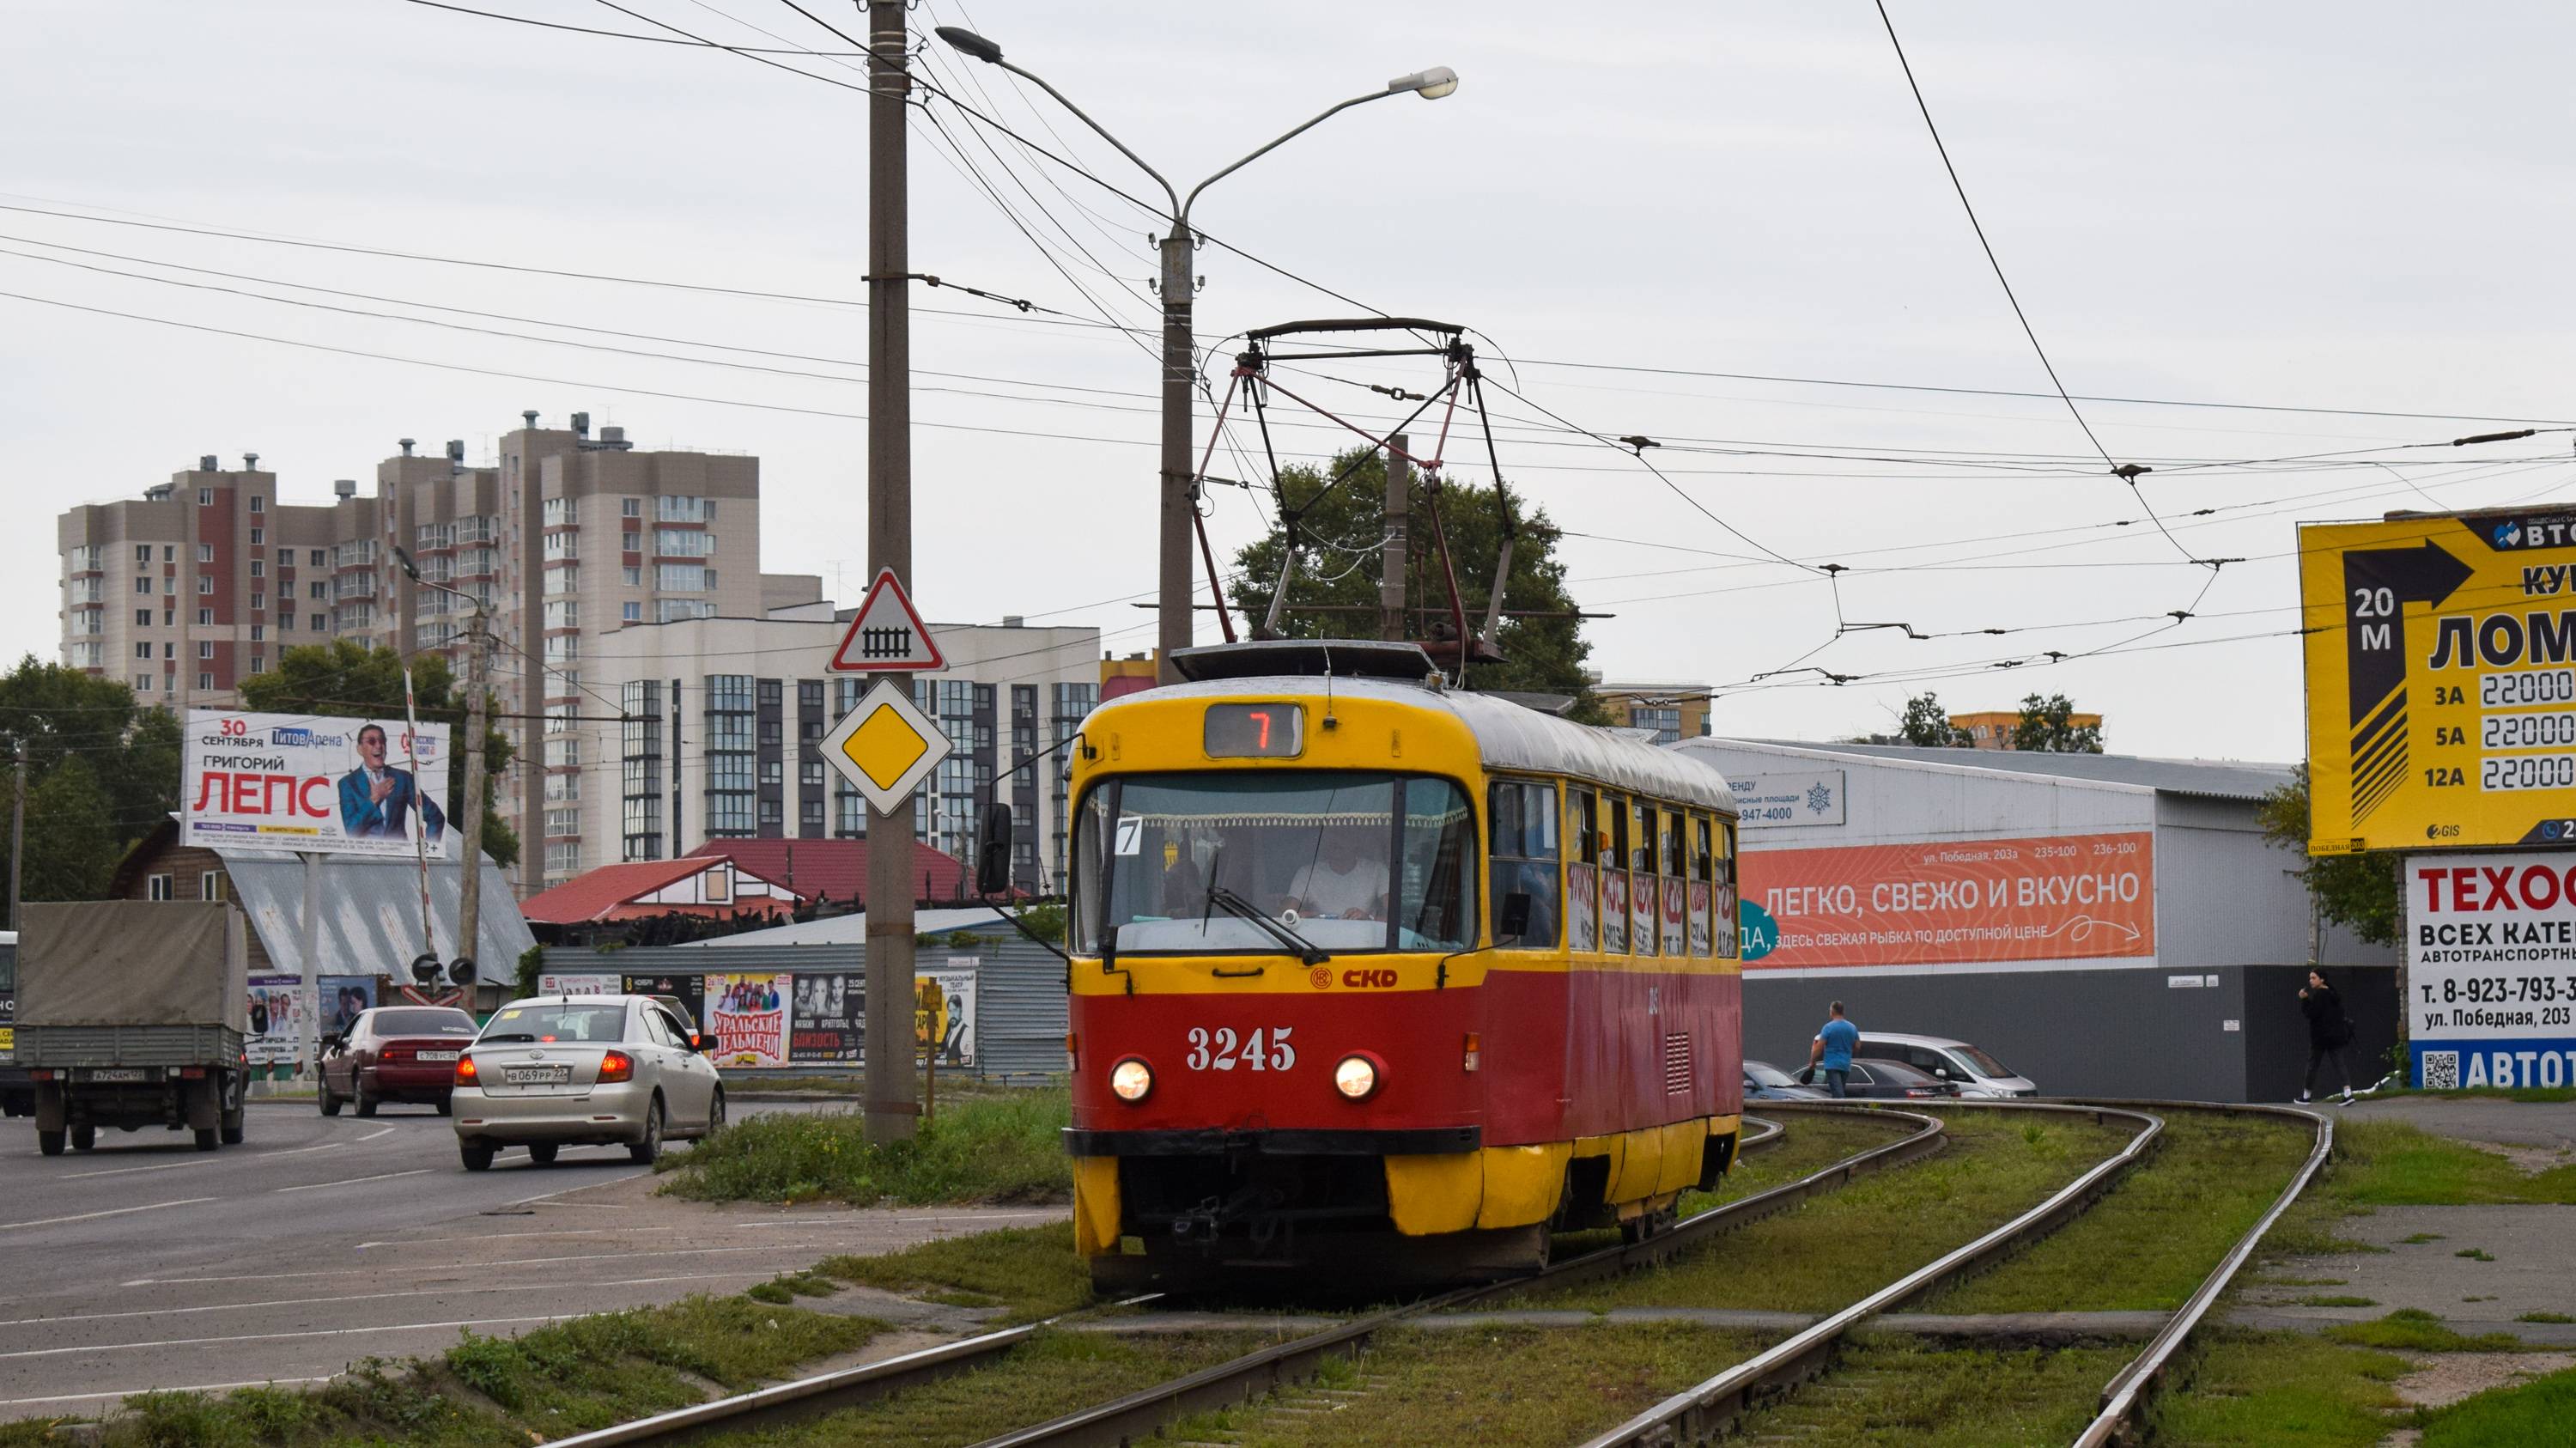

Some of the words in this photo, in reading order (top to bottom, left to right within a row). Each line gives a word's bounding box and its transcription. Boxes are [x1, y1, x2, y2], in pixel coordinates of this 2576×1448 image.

[2523, 564, 2576, 596] КУ
[2354, 587, 2394, 618] 20
[2361, 624, 2391, 650] М
[2428, 611, 2576, 670] ЛОМ
[2434, 686, 2465, 706] 3А
[2483, 670, 2573, 705] 22000
[221, 719, 246, 737] 30
[1250, 712, 1270, 750] 7
[2435, 726, 2466, 746] 5А
[2484, 714, 2575, 748] 22000
[202, 735, 264, 747] СЕНТЯБРЯ
[203, 755, 285, 770] ГРИГОРИЙ
[2424, 767, 2465, 787] 12А
[2483, 756, 2574, 789] 22000
[193, 771, 331, 818] ЛЕПС
[1765, 794, 1800, 805] площади
[1118, 819, 1139, 853] 7
[2426, 824, 2460, 840] 2GIS
[2563, 821, 2576, 837] 2
[1923, 854, 1938, 866] ул.
[1994, 848, 2018, 860] 203а
[2034, 846, 2076, 858] 235-100
[2093, 842, 2136, 855] 236-100
[2311, 843, 2350, 853] ПОБЕДНАЯ
[2351, 838, 2365, 852] 203
[1763, 885, 1863, 919] ЛЕГКО,
[1871, 879, 1979, 912] СВЕЖО
[1989, 878, 2008, 908] И
[2017, 872, 2140, 907] ВКУСНО
[1775, 934, 1814, 949] ЗДЕСЬ
[1816, 932, 1867, 946] СВЕЖАЯ
[1869, 930, 1912, 944] РЫБКА
[1915, 929, 1933, 942] ПО
[1935, 924, 2012, 944] ДОСТУПНОЙ
[2015, 924, 2048, 940] ЦЕНЕ
[2420, 923, 2494, 946] ВСЕХ
[2502, 922, 2576, 945] КАТЕ
[626, 976, 633, 991] 8
[2421, 985, 2437, 1004] т.
[2444, 976, 2576, 1004] 8-923-793-3
[714, 1011, 782, 1033] УРАЛЬСКИЕ
[2425, 1012, 2448, 1031] ул.
[2453, 1008, 2537, 1029] Победная,
[2543, 1007, 2571, 1025] 203
[793, 1032, 840, 1048] БЛИЗОСТЬ
[1187, 1026, 1297, 1071] 3245
